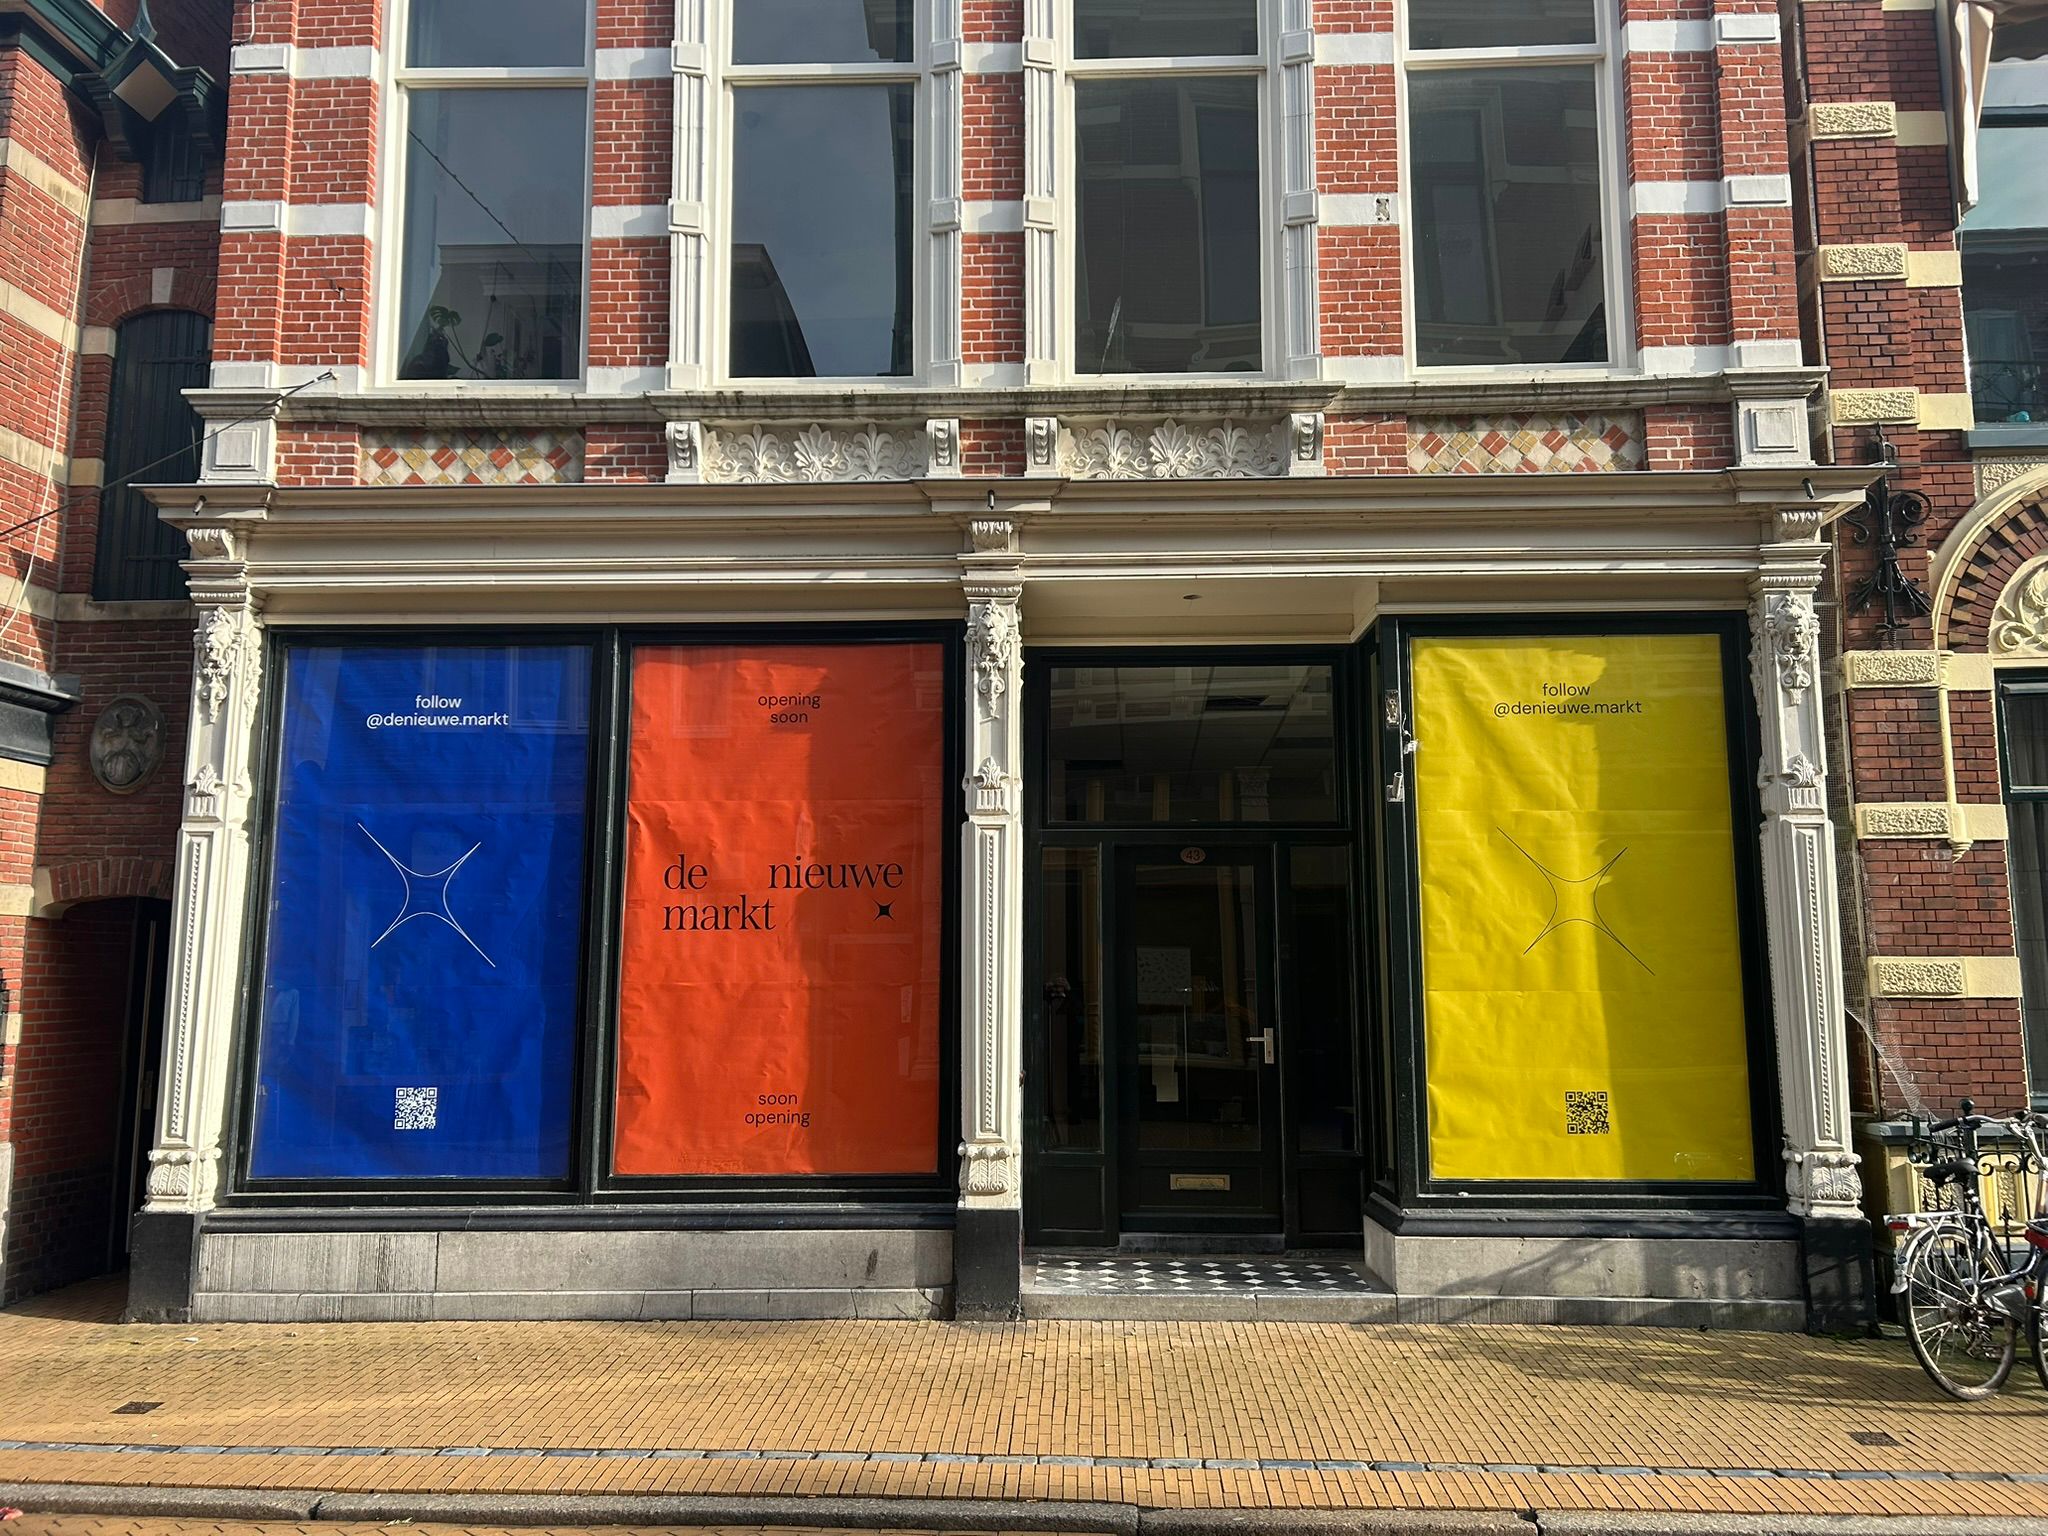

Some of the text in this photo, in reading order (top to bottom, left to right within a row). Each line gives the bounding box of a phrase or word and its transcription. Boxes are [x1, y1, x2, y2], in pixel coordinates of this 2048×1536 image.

[1542, 682, 1591, 697] follow
[415, 694, 462, 709] follow
[757, 692, 821, 709] opening
[1494, 700, 1642, 718] @denieuwe.markt
[366, 712, 509, 730] @denieuwe.markt
[770, 712, 808, 724] soon
[1184, 849, 1202, 862] 43
[663, 853, 904, 890] de nieuwe
[662, 894, 776, 931] markt
[758, 1094, 798, 1106] soon
[744, 1109, 811, 1128] opening
